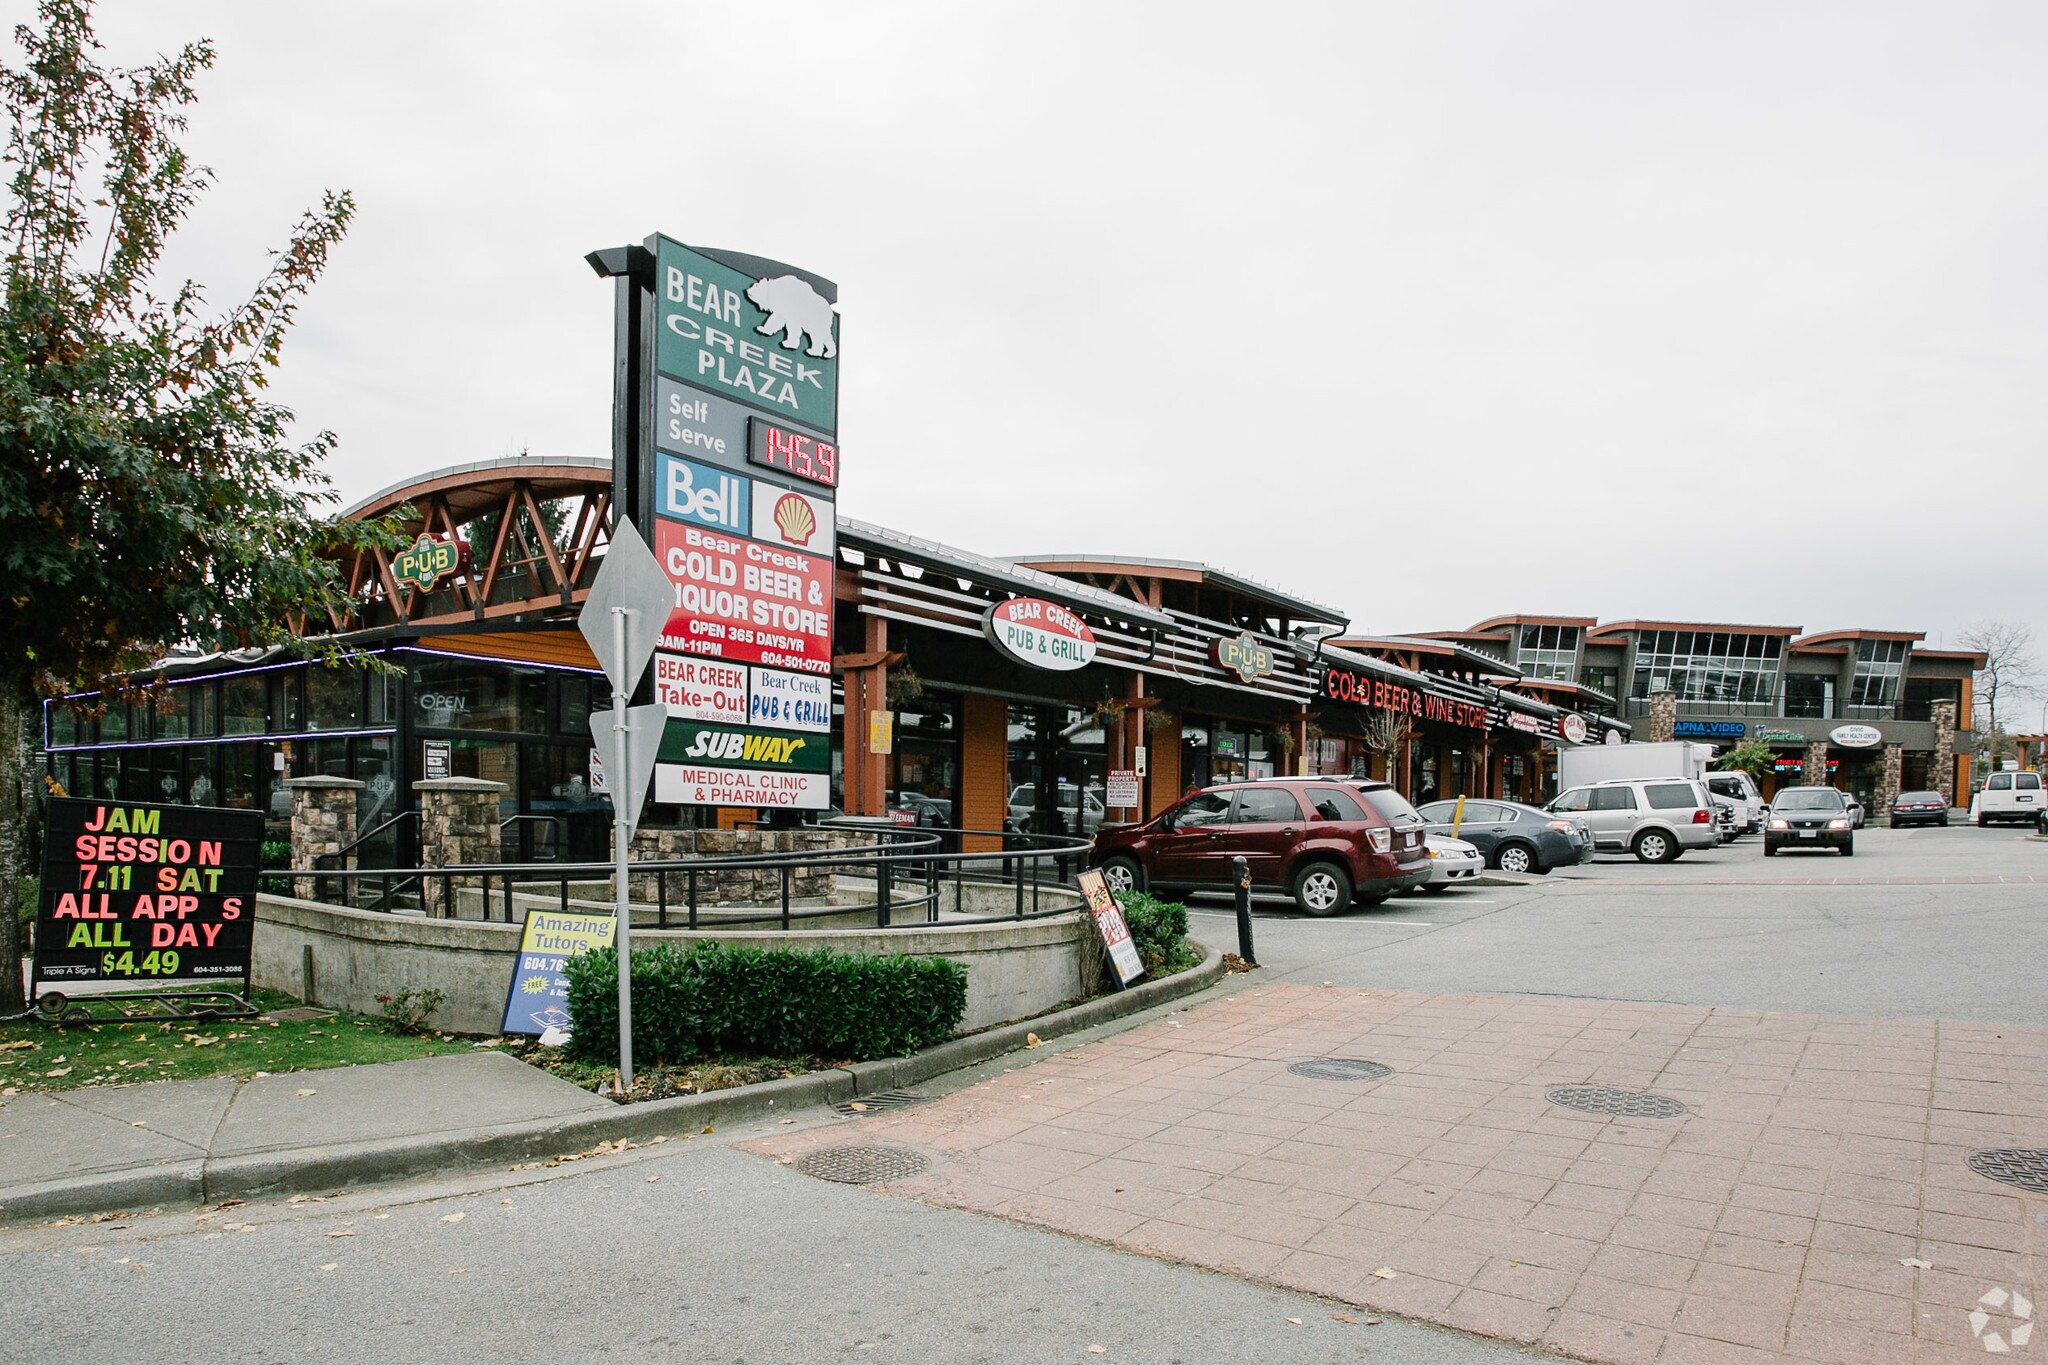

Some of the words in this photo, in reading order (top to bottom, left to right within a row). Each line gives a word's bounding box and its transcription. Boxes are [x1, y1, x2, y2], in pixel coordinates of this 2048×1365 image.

[667, 266, 741, 328] BEAR
[667, 314, 823, 390] CREEK
[698, 349, 799, 409] PLAZA
[669, 394, 708, 423] Self
[669, 419, 726, 455] Serve
[766, 427, 835, 485] 145.9
[667, 459, 740, 529] Bell
[402, 548, 449, 577] PUB
[685, 528, 741, 556] Bear
[746, 544, 809, 573] Creek
[667, 547, 737, 587] COLD
[743, 564, 803, 602] BEER
[807, 580, 823, 606] &
[671, 582, 748, 621] IQUOR
[752, 600, 829, 637] STORE
[1008, 602, 1042, 622] BEAR
[1045, 605, 1085, 641] CREEK
[656, 634, 722, 656] 9AM-11PM
[690, 619, 726, 639] OPEN
[728, 627, 754, 643] 365
[756, 632, 805, 653] DAYS/YR
[1007, 626, 1033, 650] PUB
[1037, 636, 1048, 654] &
[1051, 638, 1086, 663] GRILL
[760, 652, 831, 674] 604-501-0770
[1228, 645, 1267, 668] PUB
[658, 660, 695, 683] BEAR
[699, 666, 743, 690] CREEK
[761, 672, 788, 691] Bear
[790, 676, 821, 695] Creek
[420, 694, 465, 709] OPEN
[659, 683, 745, 713] Take-Out
[752, 694, 778, 721] PUB
[783, 701, 790, 721] &
[795, 699, 829, 727] GRILL
[1328, 669, 1371, 704] COLD
[1374, 681, 1410, 713] BEER
[1411, 691, 1421, 716] &
[1424, 694, 1454, 723] WINE
[1456, 703, 1488, 730] STORE
[1675, 722, 1705, 732] APNA
[1710, 723, 1745, 733] VIDEO
[686, 731, 806, 763] SUBWAY
[369, 782, 390, 791] PUB
[682, 770, 756, 788] MEDICAL
[760, 775, 808, 790] CLINIC
[694, 788, 705, 801] &
[711, 788, 798, 805] PHARMACY
[84, 806, 161, 835] JAM
[157, 867, 224, 892] SAT
[53, 893, 118, 919] ALL
[132, 894, 199, 920] APP
[68, 923, 130, 948] ALL
[152, 923, 223, 948] DAY
[533, 915, 610, 937] Amazing
[535, 933, 588, 951] Tutors
[42, 966, 65, 976] Triple
[66, 967, 73, 975] A
[75, 966, 96, 975] Signs
[103, 951, 180, 976] $4.49
[527, 980, 543, 990] FREE
